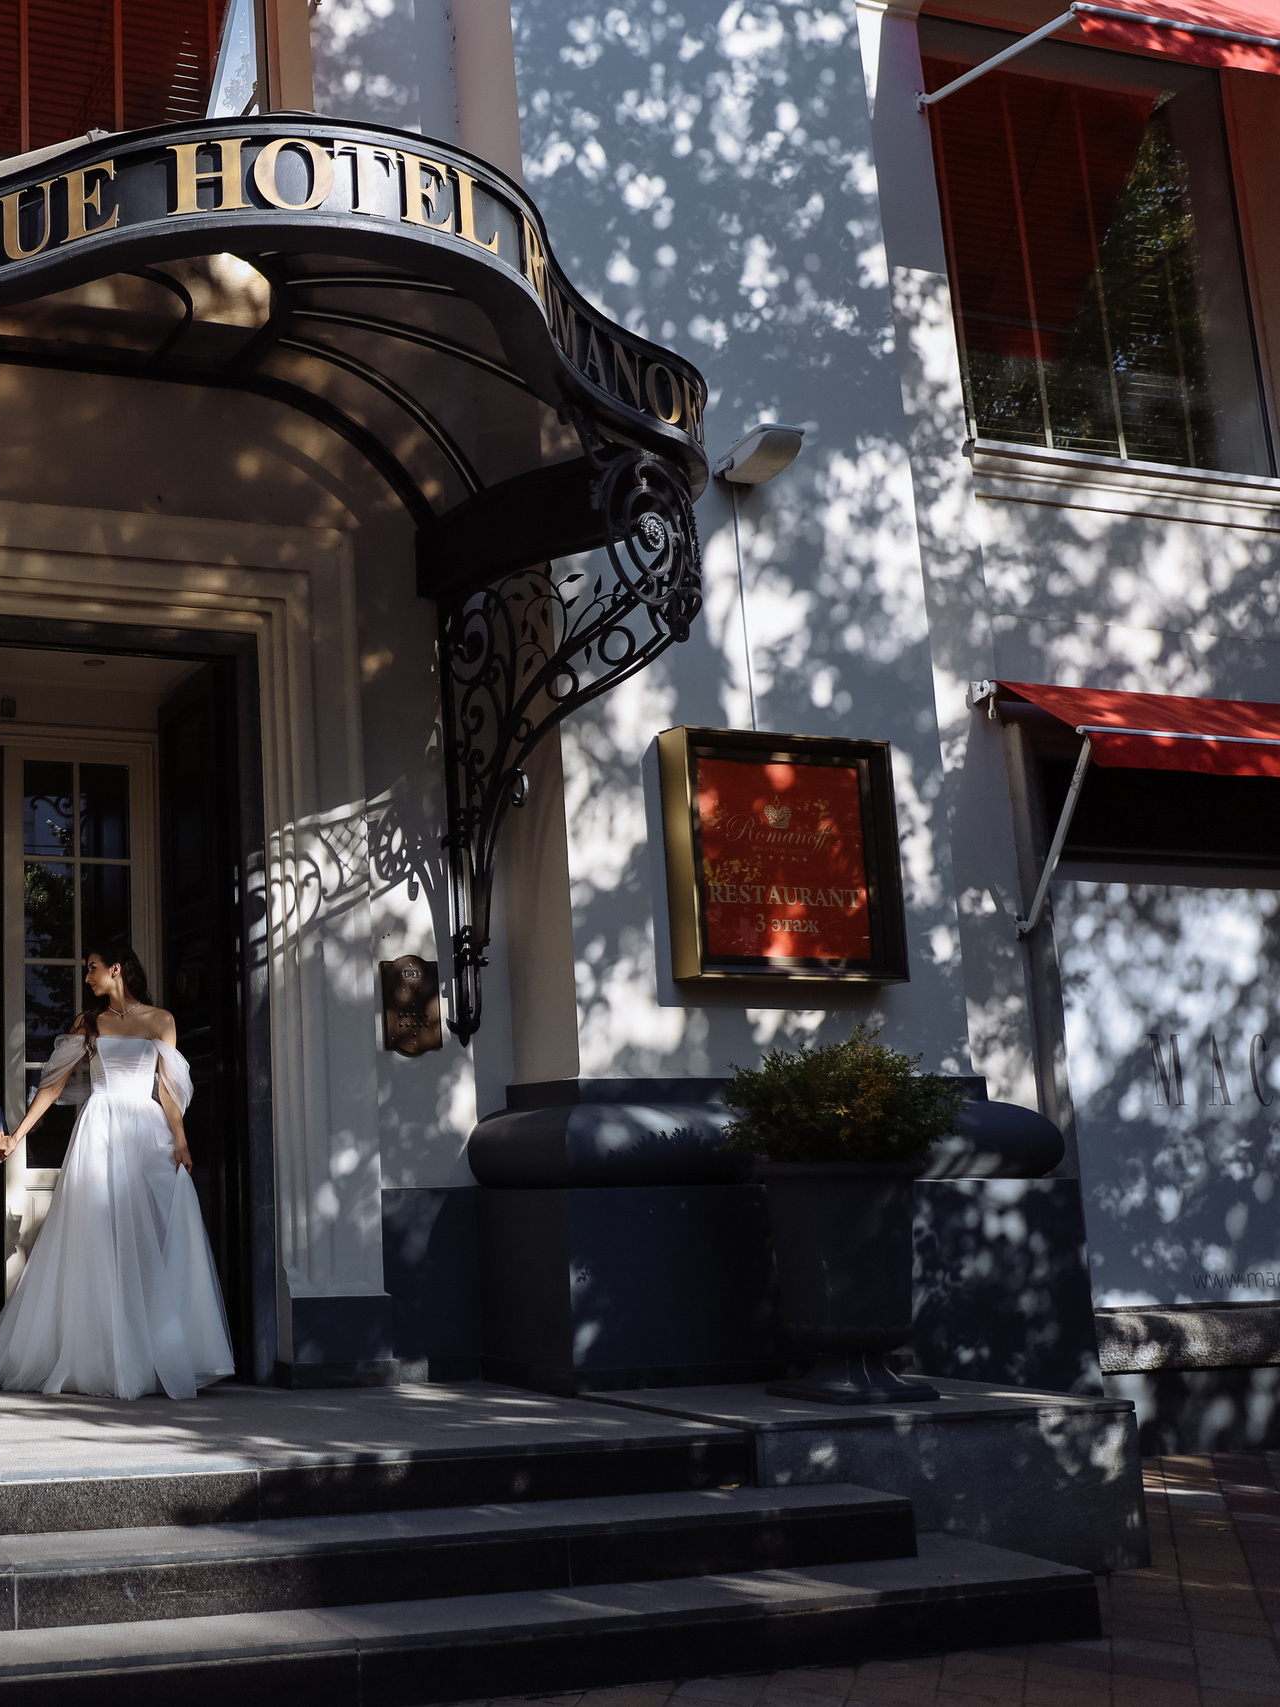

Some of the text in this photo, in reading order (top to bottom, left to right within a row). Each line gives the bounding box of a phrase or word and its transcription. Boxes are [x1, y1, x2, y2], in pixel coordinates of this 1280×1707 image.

[166, 137, 498, 254] HOTEL
[520, 211, 705, 446] ROMANOF
[725, 813, 835, 854] Romanoff
[709, 884, 861, 908] RESTAURANT
[755, 913, 819, 933] 3 этаж
